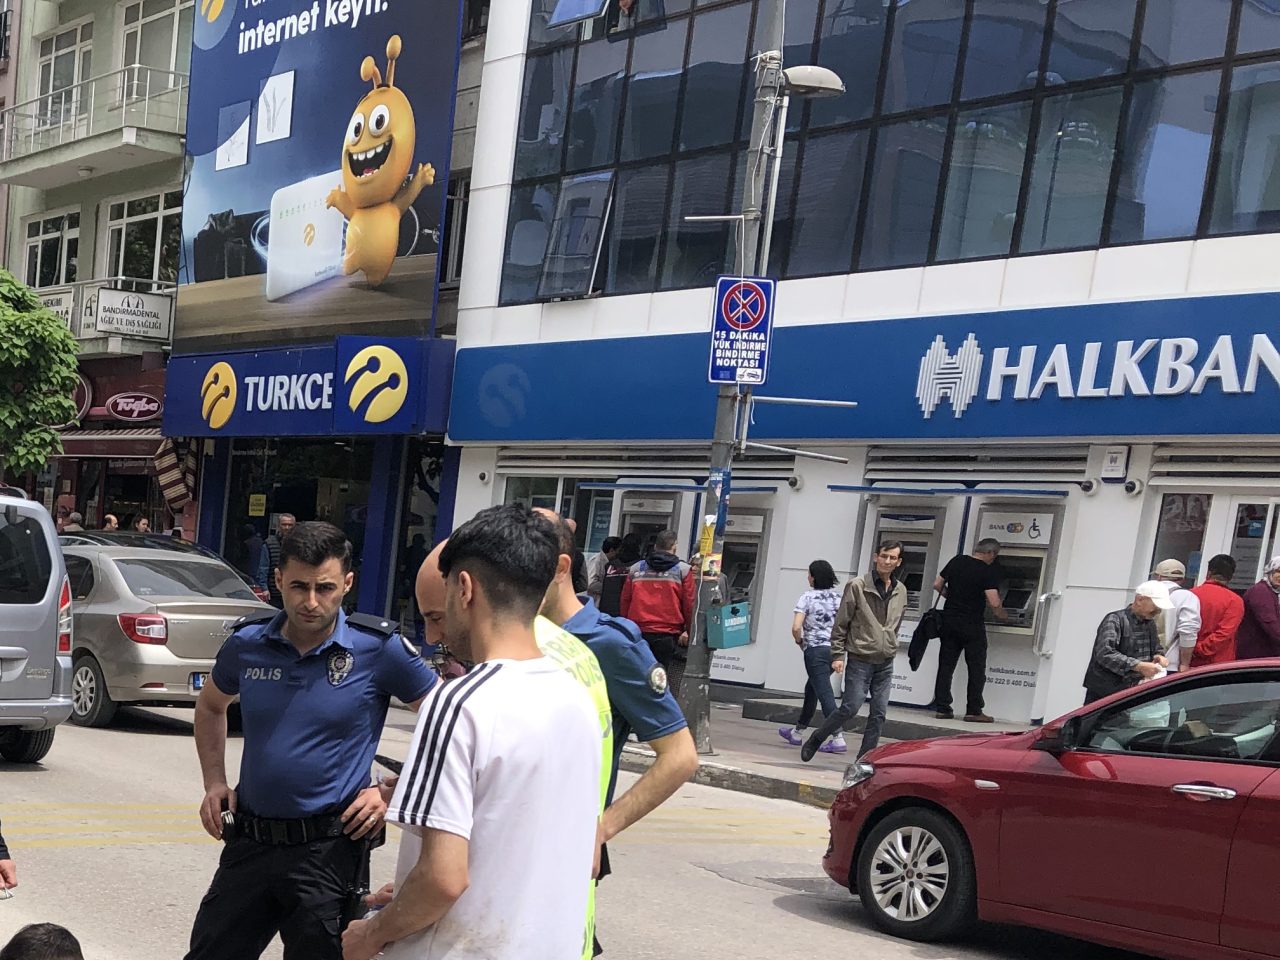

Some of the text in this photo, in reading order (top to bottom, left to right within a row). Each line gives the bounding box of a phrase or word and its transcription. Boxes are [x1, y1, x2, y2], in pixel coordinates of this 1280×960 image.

[238, 2, 320, 54] internet
[715, 331, 765, 340] 15 DAKİKA
[714, 339, 766, 351] YÜK İNDİRME
[716, 350, 760, 360] BİNDİRME
[716, 358, 759, 368] NOKTASI
